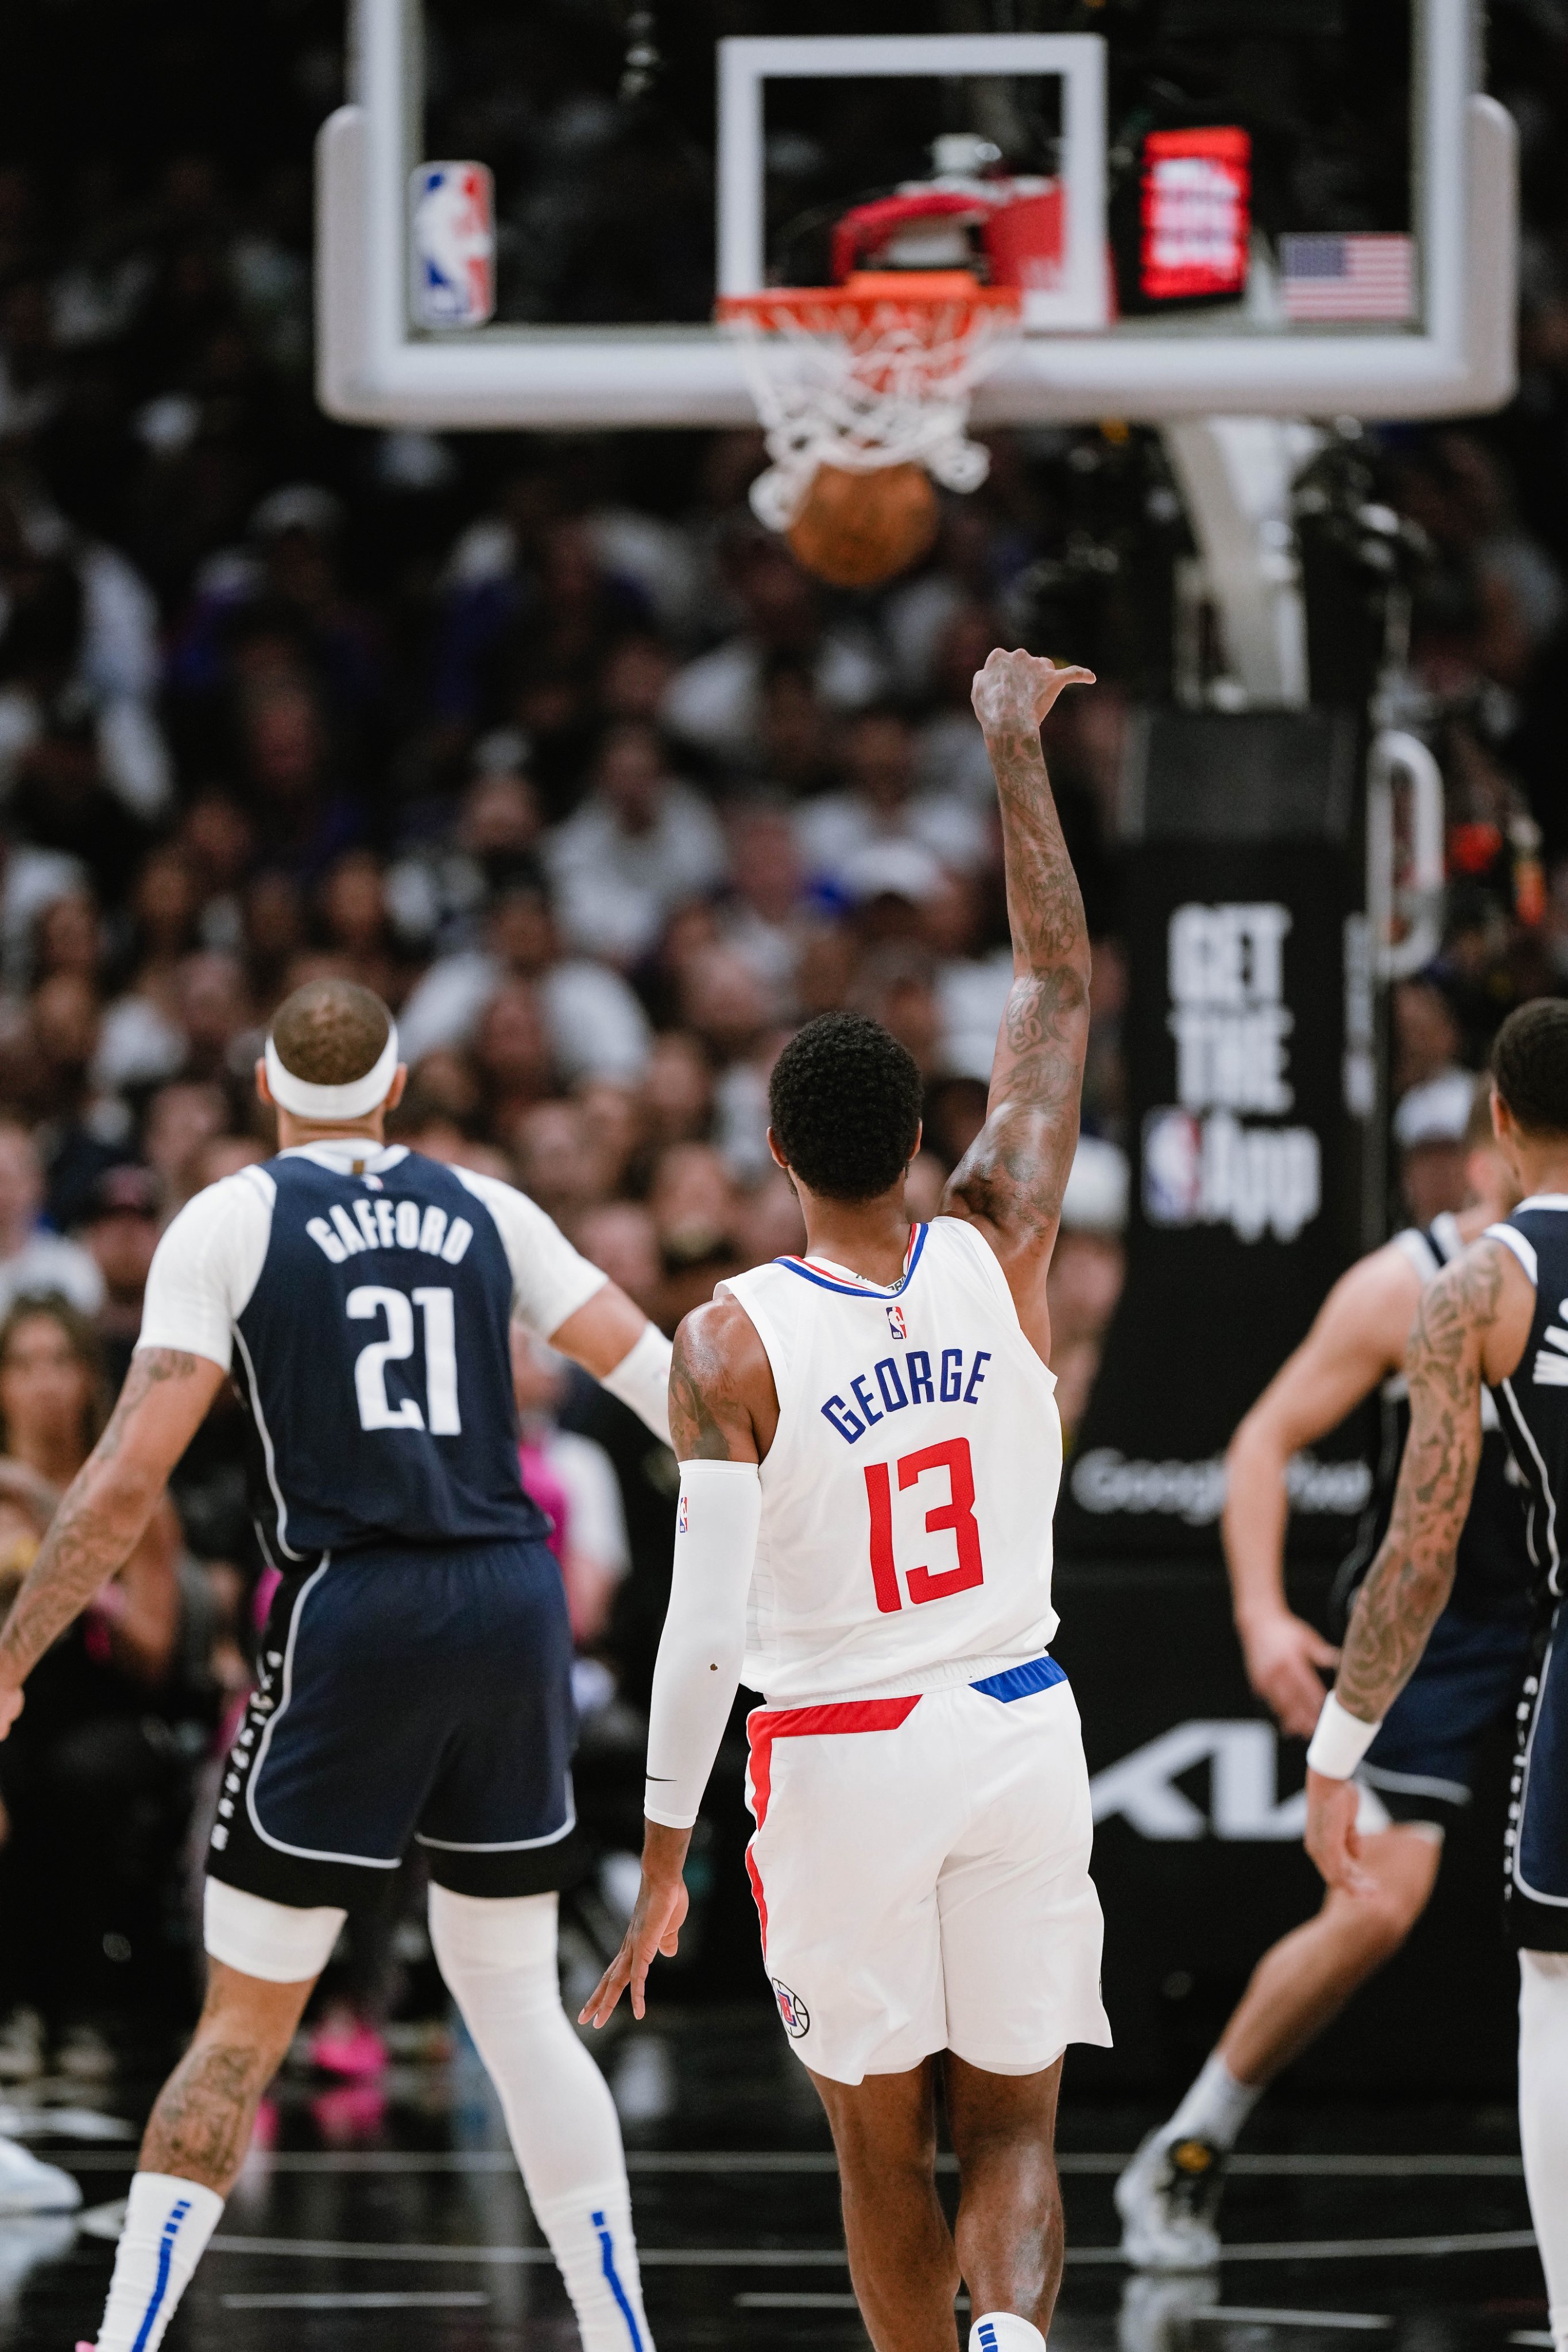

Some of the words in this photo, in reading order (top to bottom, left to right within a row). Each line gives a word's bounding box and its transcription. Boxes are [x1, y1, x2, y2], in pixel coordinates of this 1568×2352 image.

[1169, 903, 1291, 1000] GET
[1168, 1005, 1293, 1115] THE
[305, 1199, 474, 1264] GAFFORD
[1203, 1109, 1319, 1244] App
[346, 1285, 461, 1436] 21
[821, 1349, 992, 1444] GEORGE
[864, 1437, 984, 1613] 13
